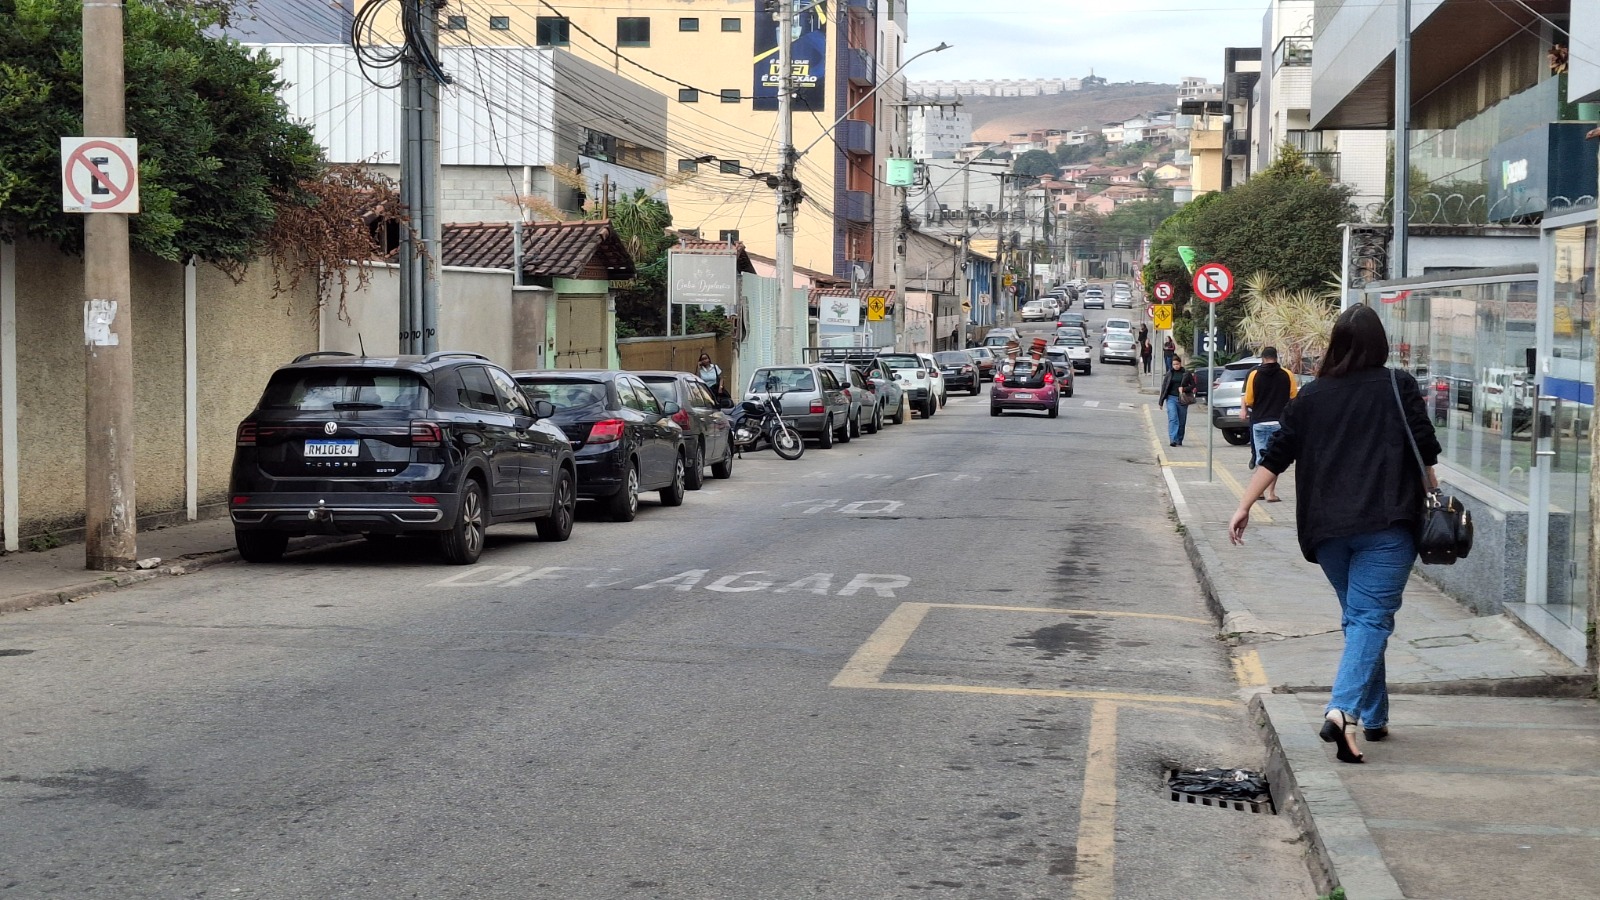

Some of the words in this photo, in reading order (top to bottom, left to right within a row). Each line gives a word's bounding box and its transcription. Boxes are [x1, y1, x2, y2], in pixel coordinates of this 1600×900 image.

[774, 66, 804, 74] WFI
[761, 74, 768, 82] É
[90, 156, 110, 195] E
[1206, 272, 1220, 293] E
